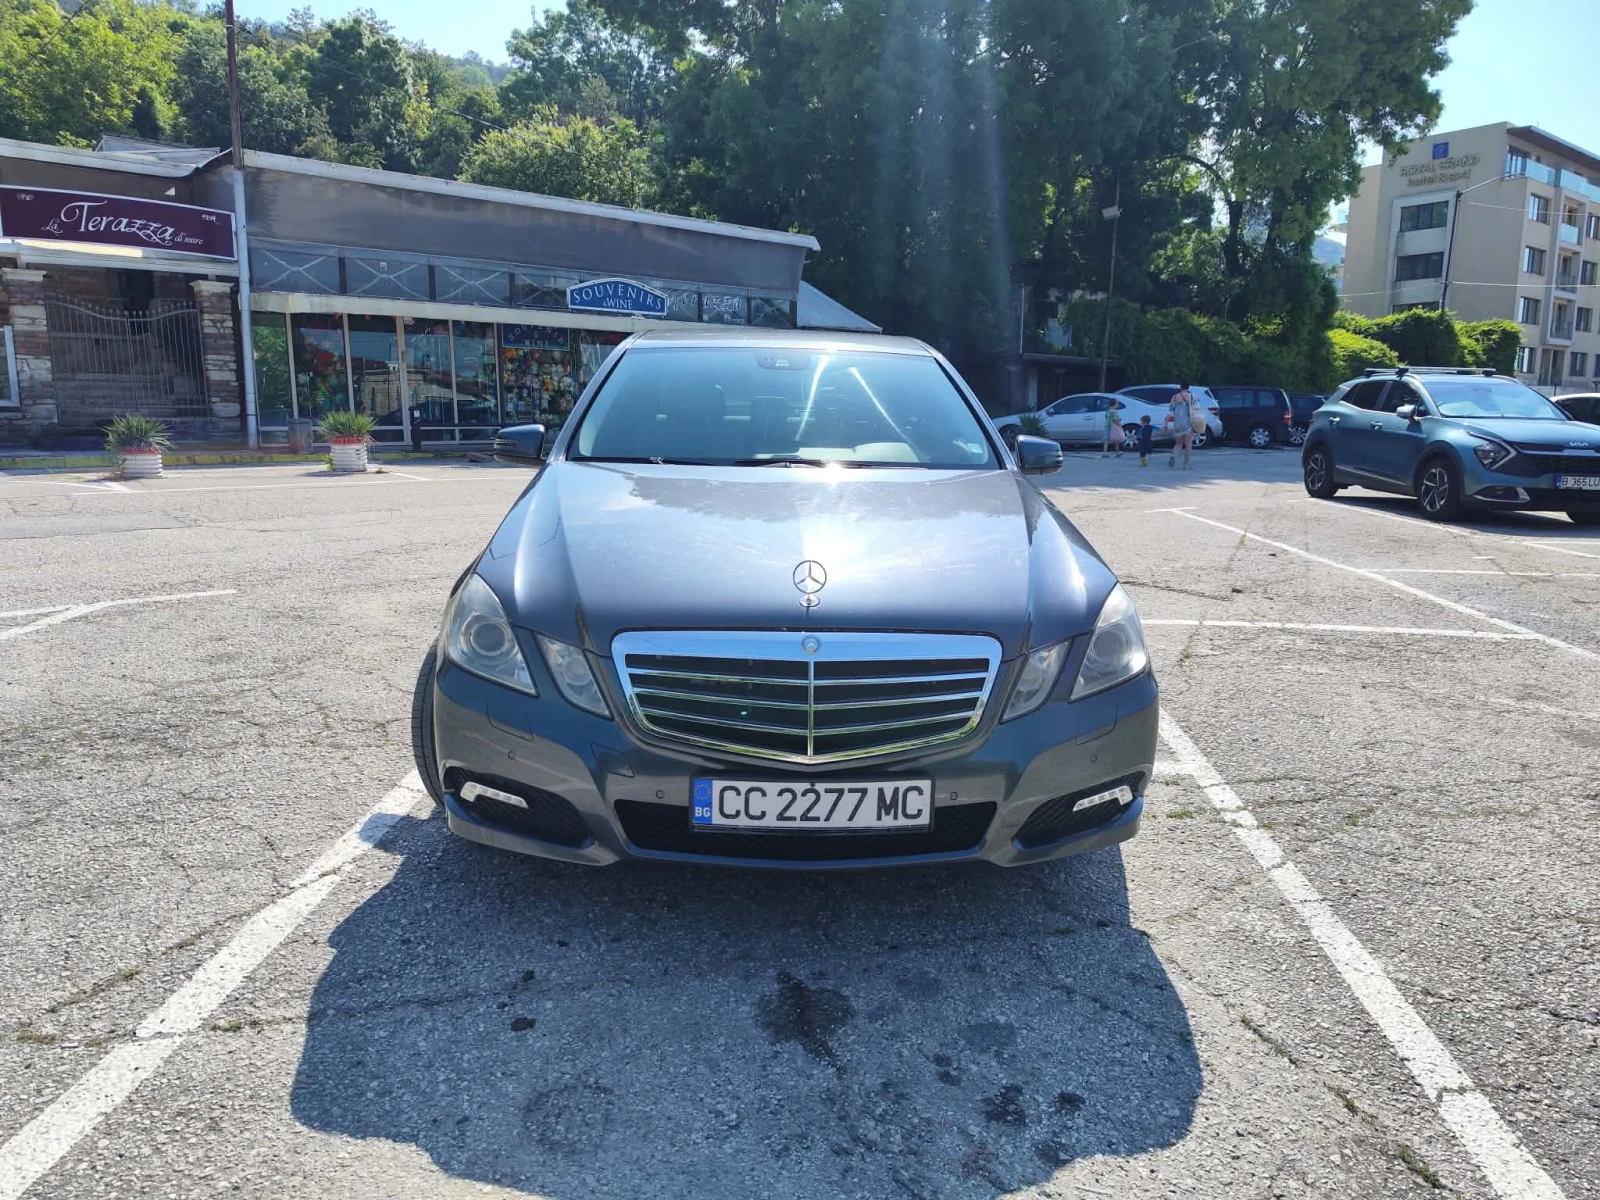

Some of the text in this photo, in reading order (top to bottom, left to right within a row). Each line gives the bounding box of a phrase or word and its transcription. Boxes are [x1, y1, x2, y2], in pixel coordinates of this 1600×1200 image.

[1400, 155, 1480, 176] ROYAL GRAND
[41, 218, 63, 236] La
[61, 200, 174, 246] Terazza
[573, 283, 662, 310] SOUVENIRS
[1562, 477, 1569, 486] B
[694, 806, 711, 817] BG
[718, 785, 924, 822] CC 2277 MC
